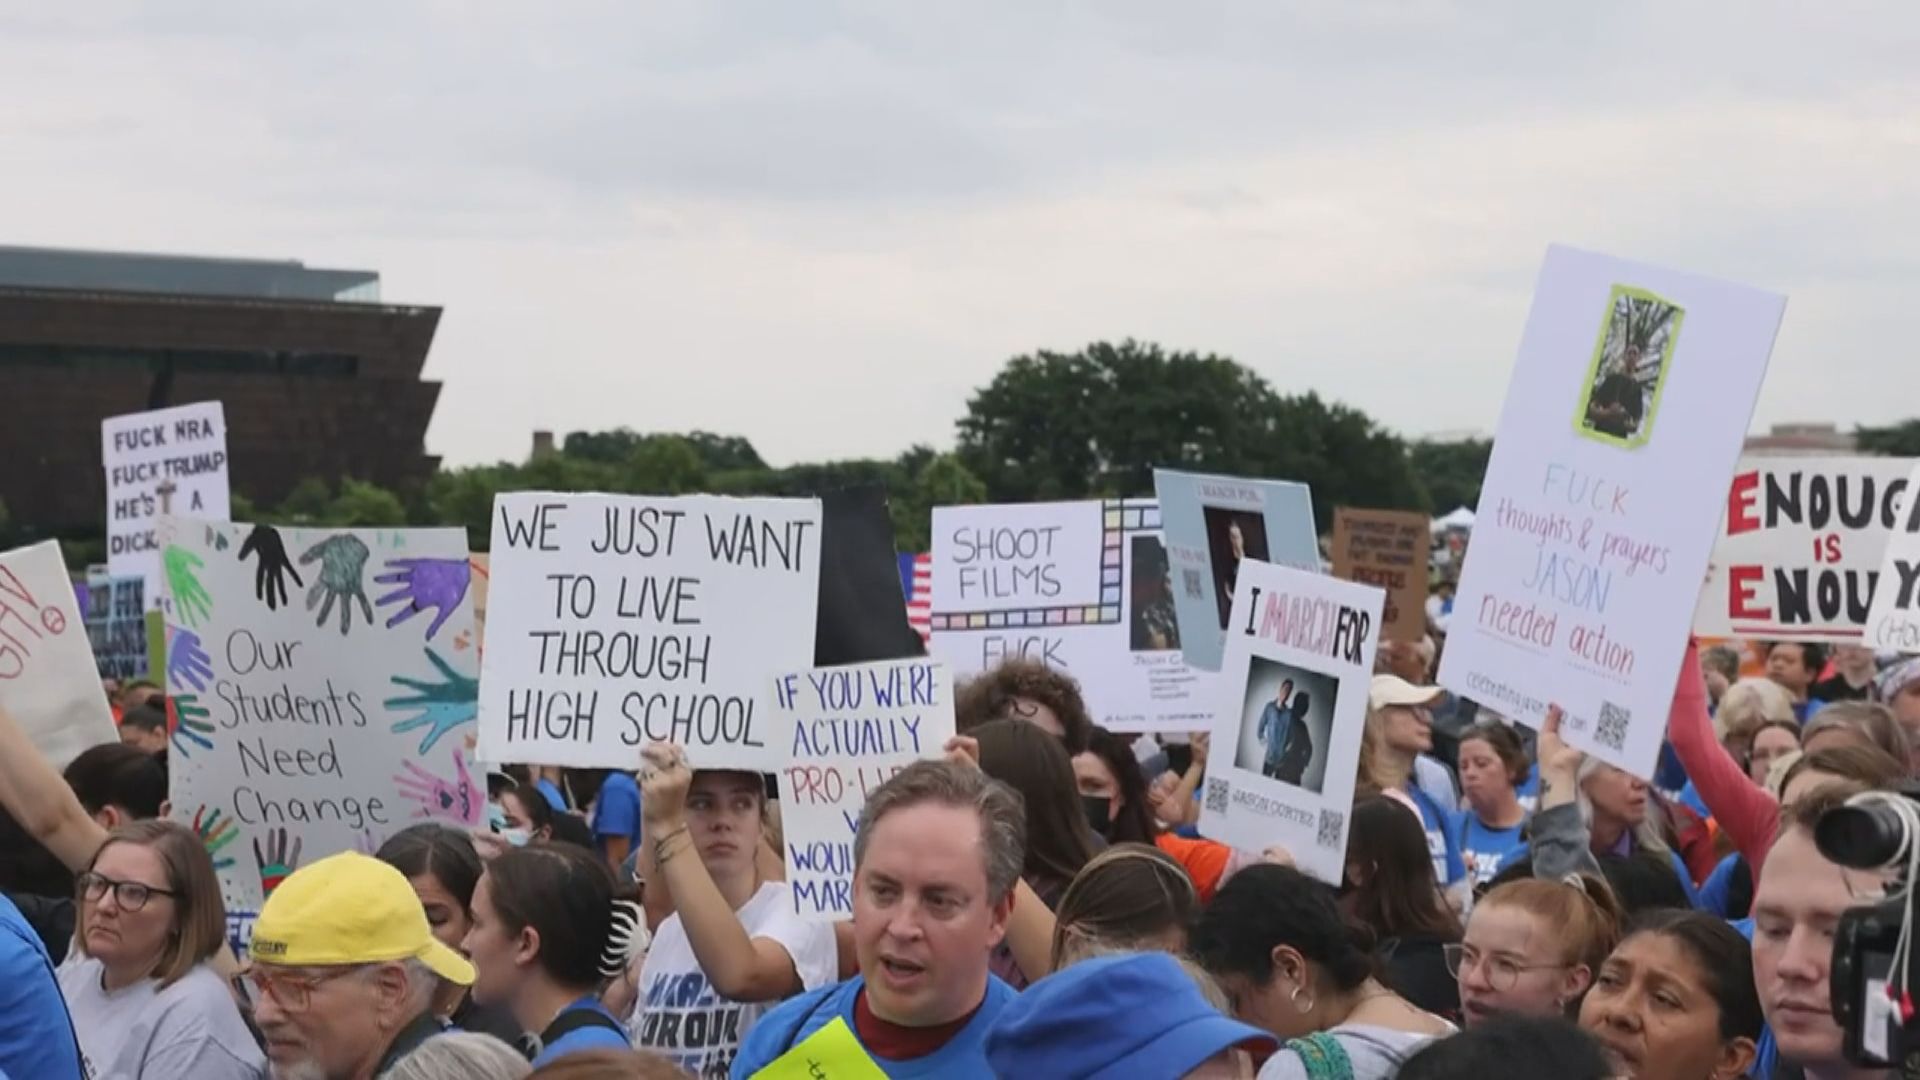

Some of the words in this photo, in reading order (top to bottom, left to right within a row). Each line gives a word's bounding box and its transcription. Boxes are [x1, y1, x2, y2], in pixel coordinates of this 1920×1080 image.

[114, 425, 166, 453] FUCK
[175, 418, 214, 441] NRA
[112, 461, 159, 488] FUCK
[163, 451, 225, 476] TRUMP
[1543, 462, 1629, 516] FUCK
[115, 491, 155, 520] HE'S
[191, 490, 203, 511] A
[1727, 470, 1909, 536] ENOUG
[112, 532, 159, 555] DICK
[502, 505, 567, 552] WE
[591, 507, 685, 557] JUST
[704, 513, 814, 573] WANT
[952, 526, 1063, 564] SHOOT
[1496, 497, 1573, 547] thoughts
[1578, 518, 1593, 552] &
[1598, 532, 1670, 577] prayers
[1813, 533, 1842, 564] IS
[547, 574, 595, 620] TO
[617, 576, 702, 625] LIVE
[959, 564, 1062, 599] FILMS
[1521, 550, 1612, 614] JASON
[1729, 565, 1879, 625] ENOU
[1245, 586, 1261, 636] I
[1260, 592, 1337, 657] MARCH
[1332, 605, 1370, 667] FOR
[1478, 594, 1558, 648] needed
[1569, 624, 1635, 676] action
[226, 628, 303, 675] Our
[529, 631, 711, 684] THROUGH
[215, 680, 367, 729] Students
[776, 674, 798, 710] IF
[808, 670, 862, 711] YOU
[869, 663, 945, 708] WERE
[507, 690, 598, 743] HIGH
[621, 691, 764, 748] SCHOOL
[792, 715, 921, 757] ACTUALLY
[237, 738, 343, 779] Need
[233, 786, 389, 830] Change
[792, 878, 853, 915] MAR
